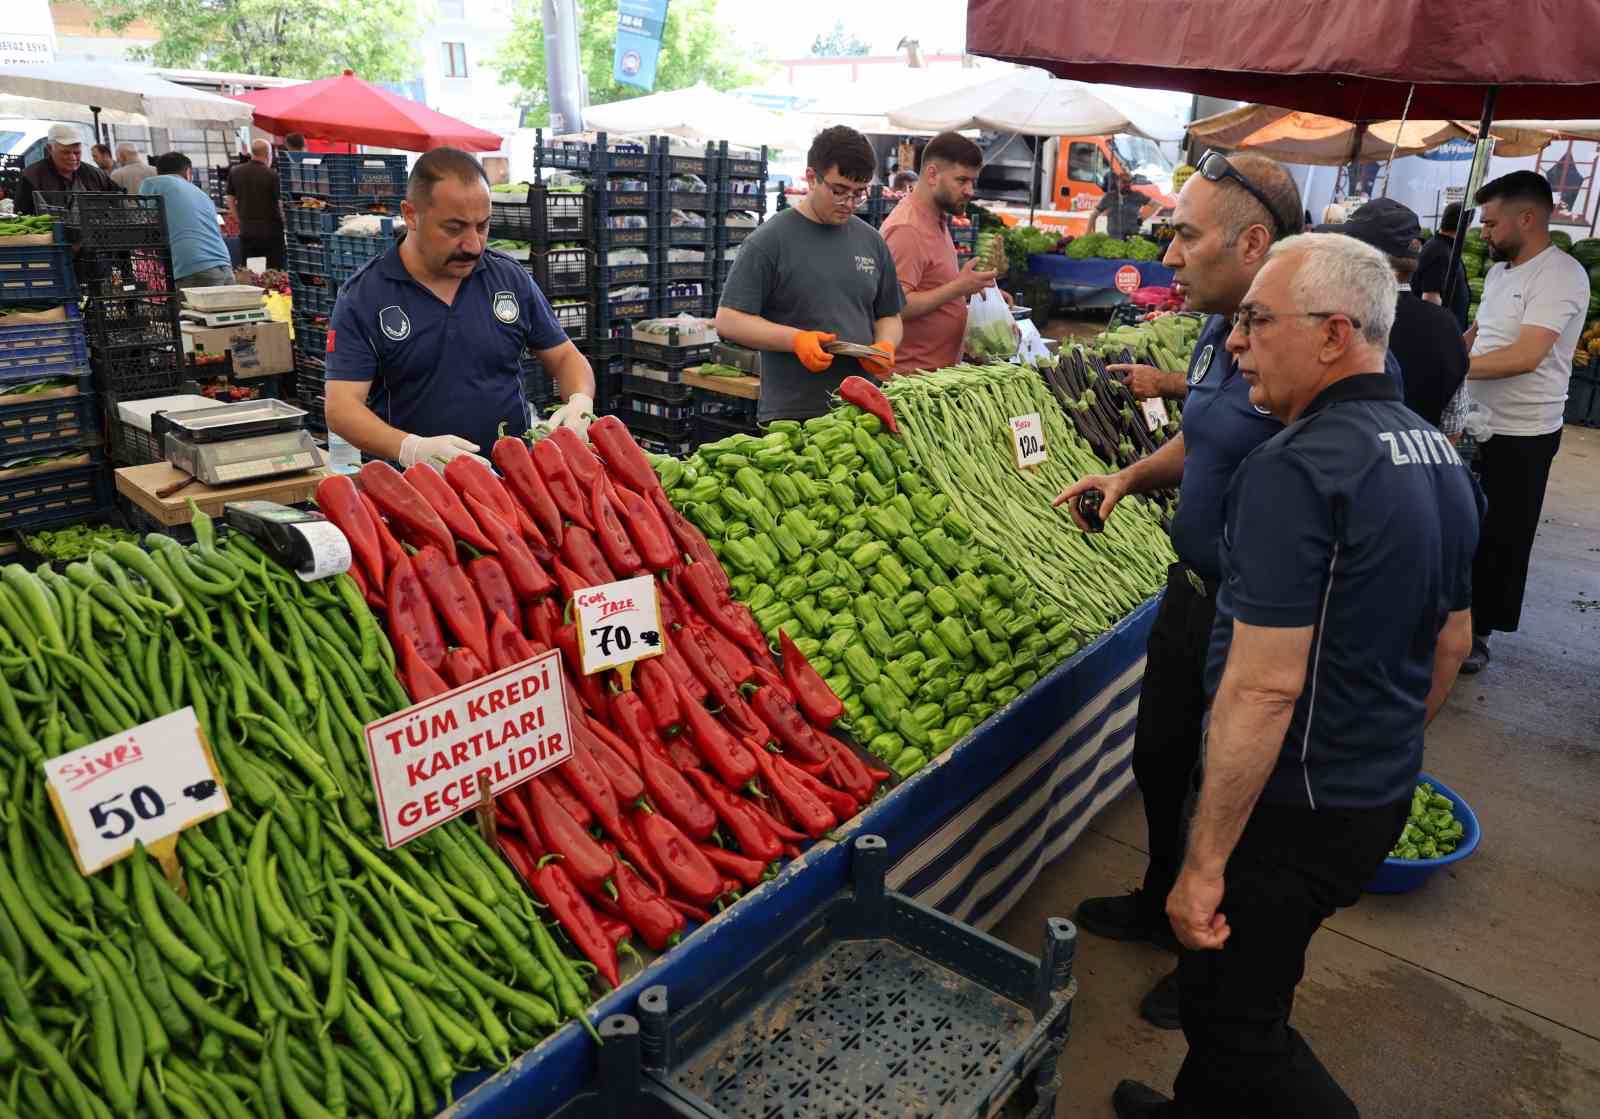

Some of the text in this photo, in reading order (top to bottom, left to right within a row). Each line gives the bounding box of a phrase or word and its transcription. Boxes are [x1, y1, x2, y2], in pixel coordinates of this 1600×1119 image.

[598, 598, 635, 615] TAZE
[385, 664, 550, 755] TÜM KREDİ
[406, 706, 545, 787] KARTLARI
[398, 733, 564, 827] GEÇERLİDİR
